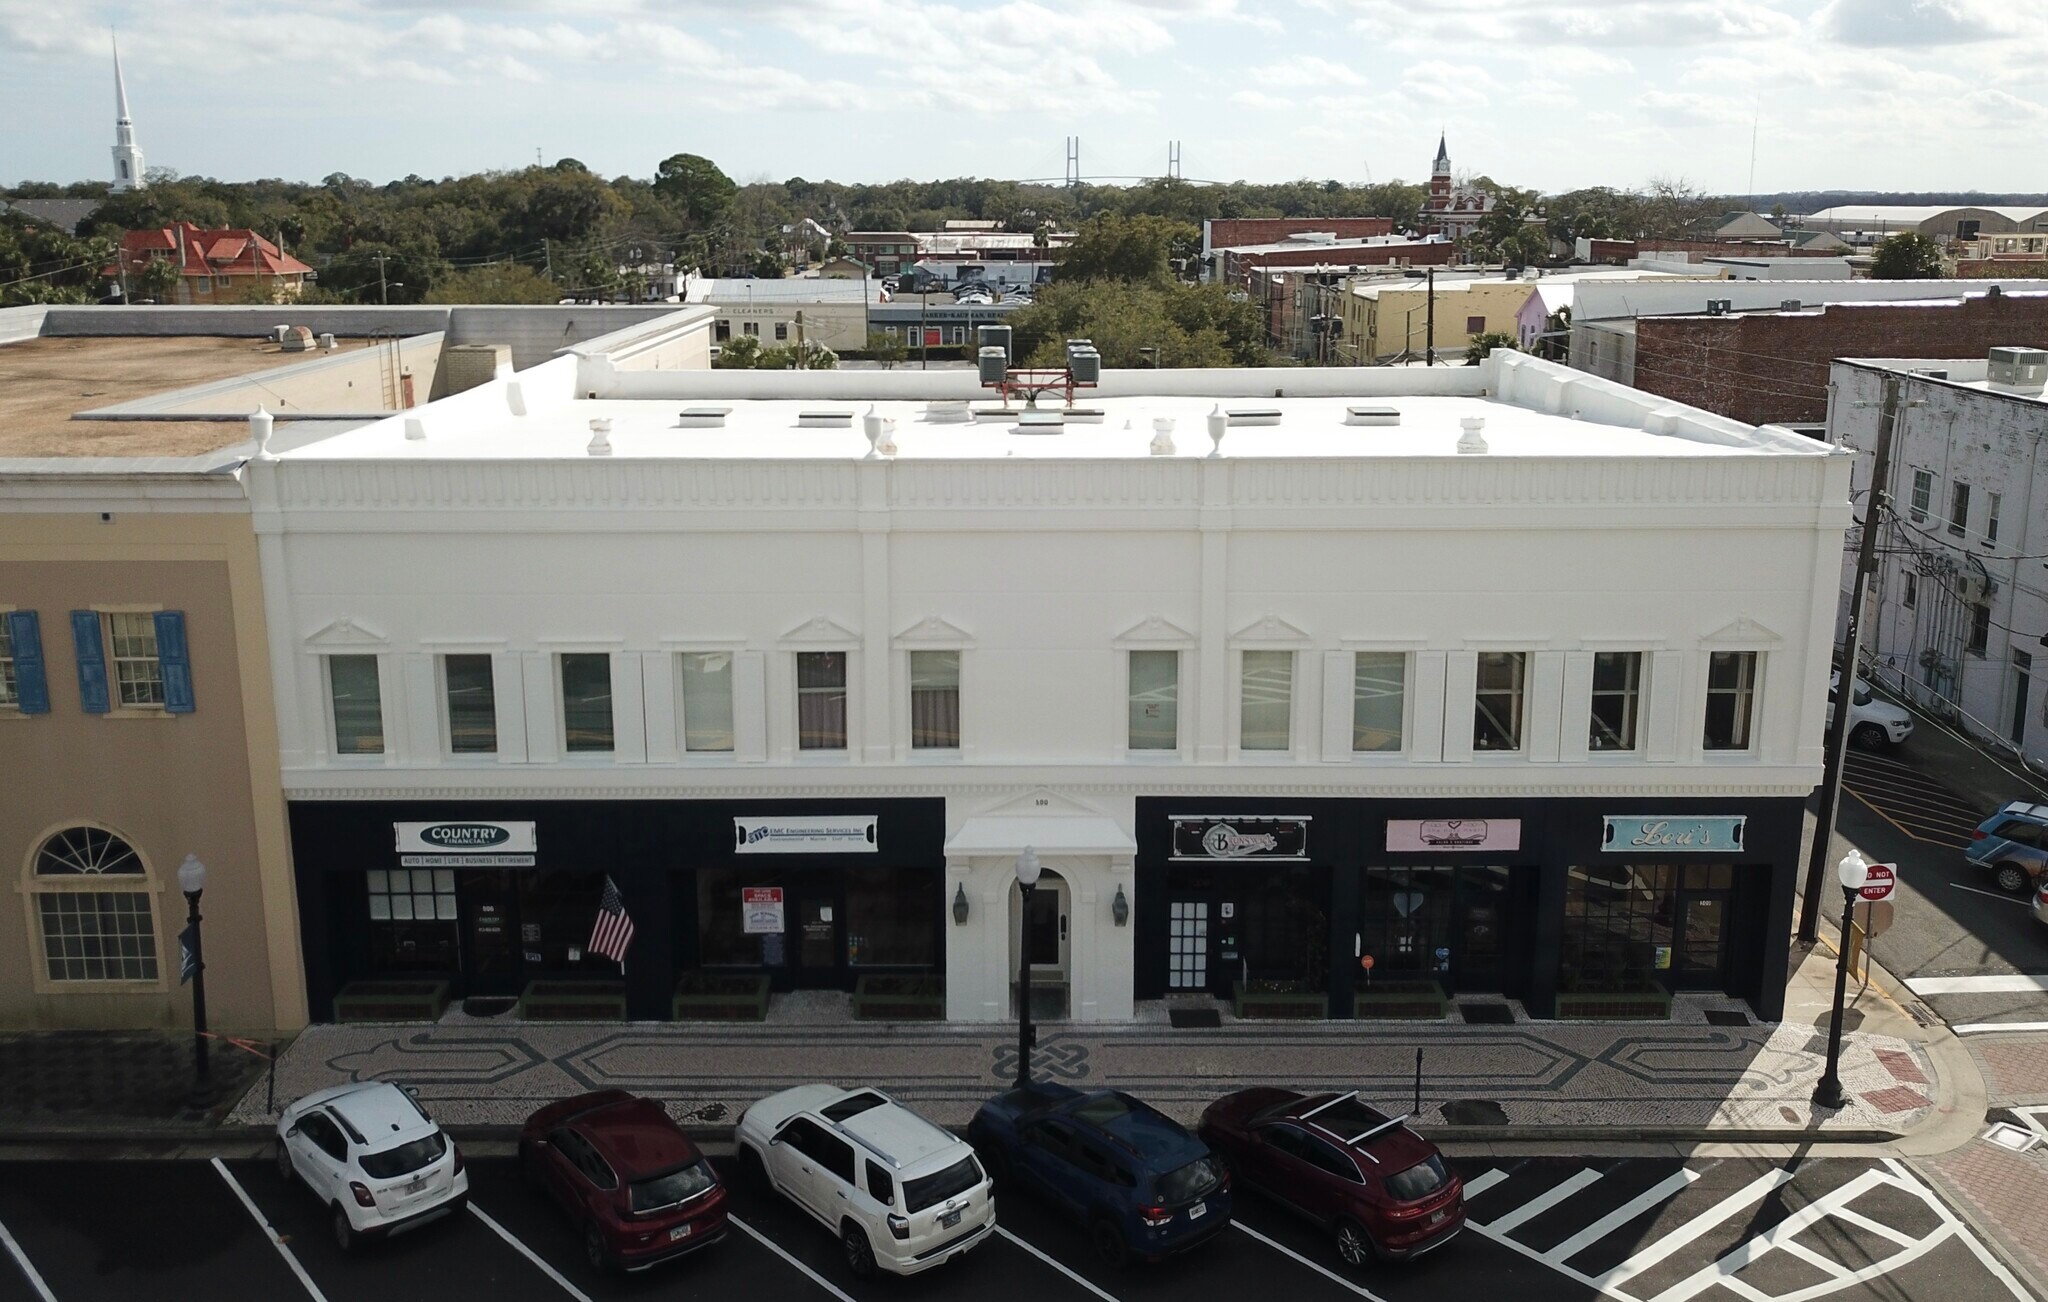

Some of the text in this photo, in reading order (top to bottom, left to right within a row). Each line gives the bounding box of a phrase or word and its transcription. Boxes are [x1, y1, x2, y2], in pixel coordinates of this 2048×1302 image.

[431, 827, 498, 839] COUNTRY
[1631, 821, 1712, 846] Lori's
[1864, 887, 1886, 895] ENTER
